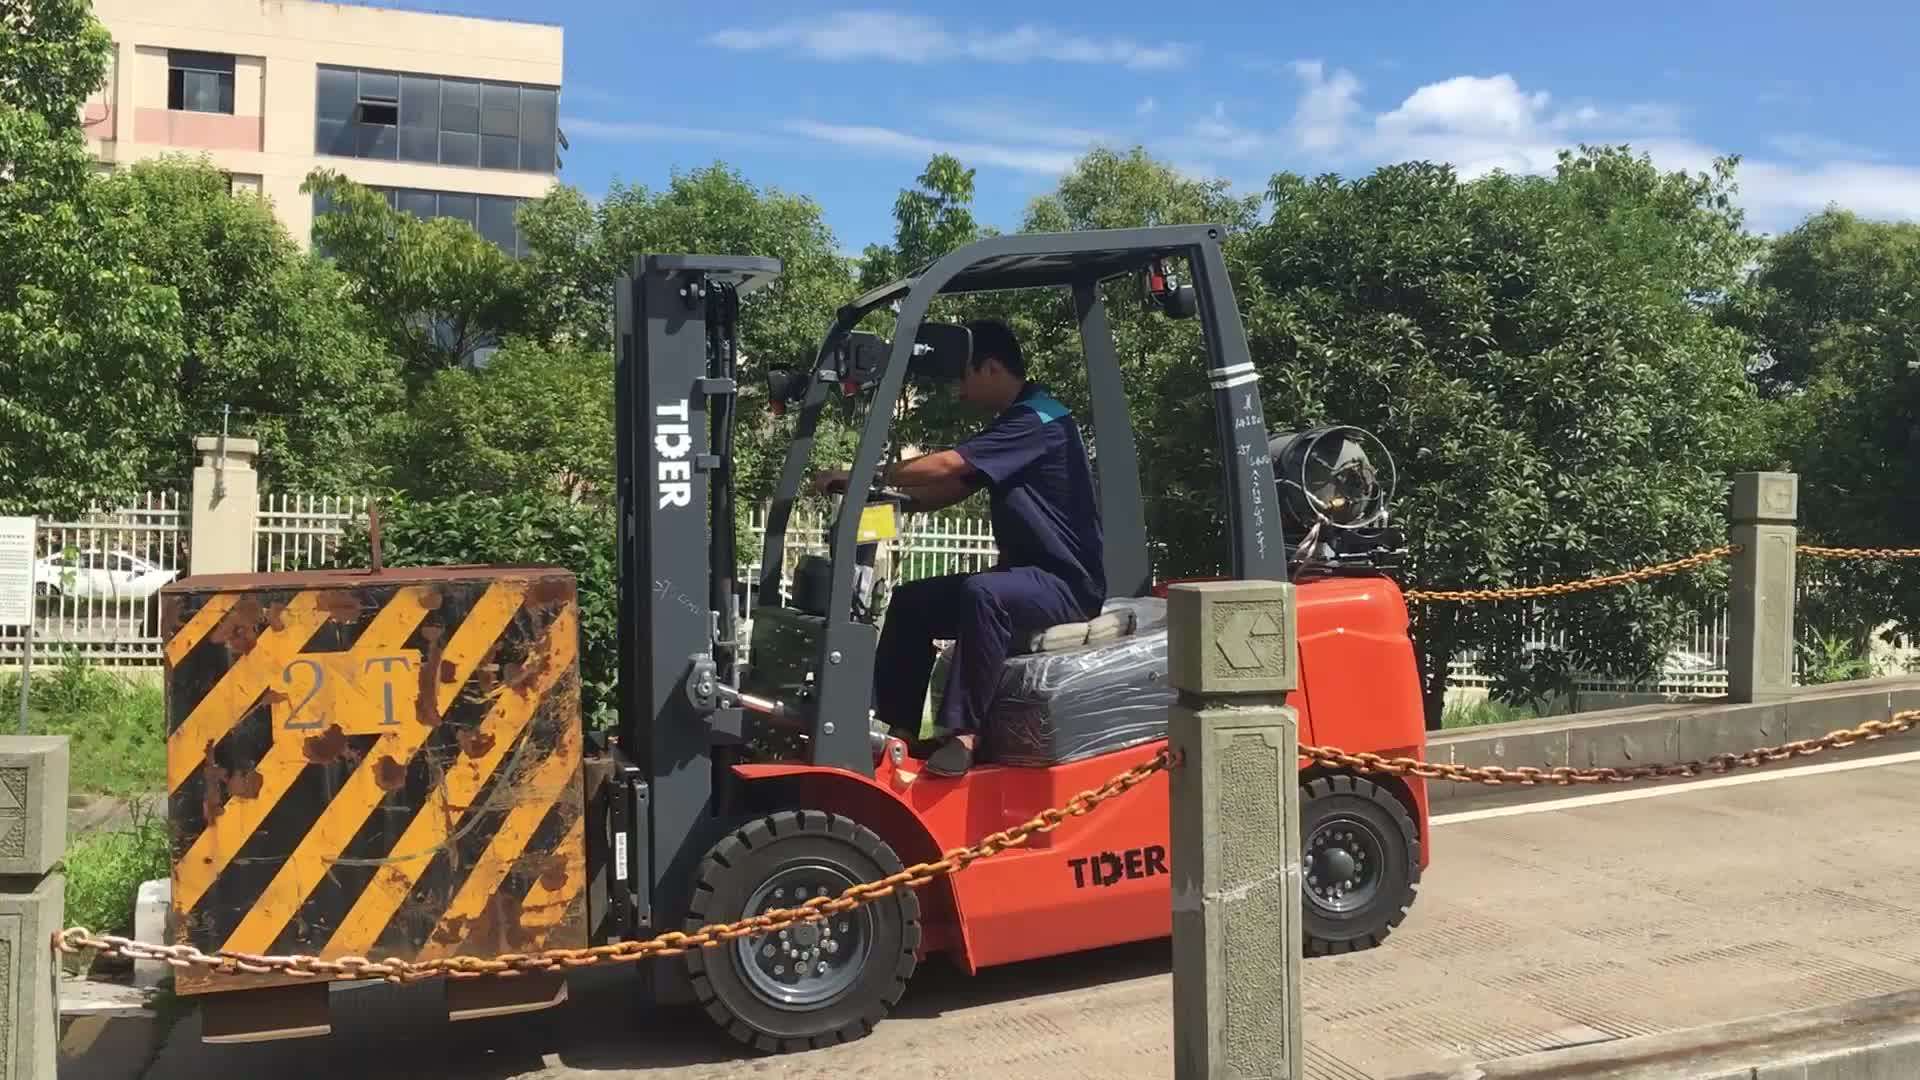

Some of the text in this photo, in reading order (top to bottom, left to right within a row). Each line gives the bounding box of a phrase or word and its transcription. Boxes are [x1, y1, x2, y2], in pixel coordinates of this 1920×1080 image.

[654, 399, 692, 510] TIDER
[283, 656, 411, 729] 2 T
[1067, 845, 1169, 888] TIDER
